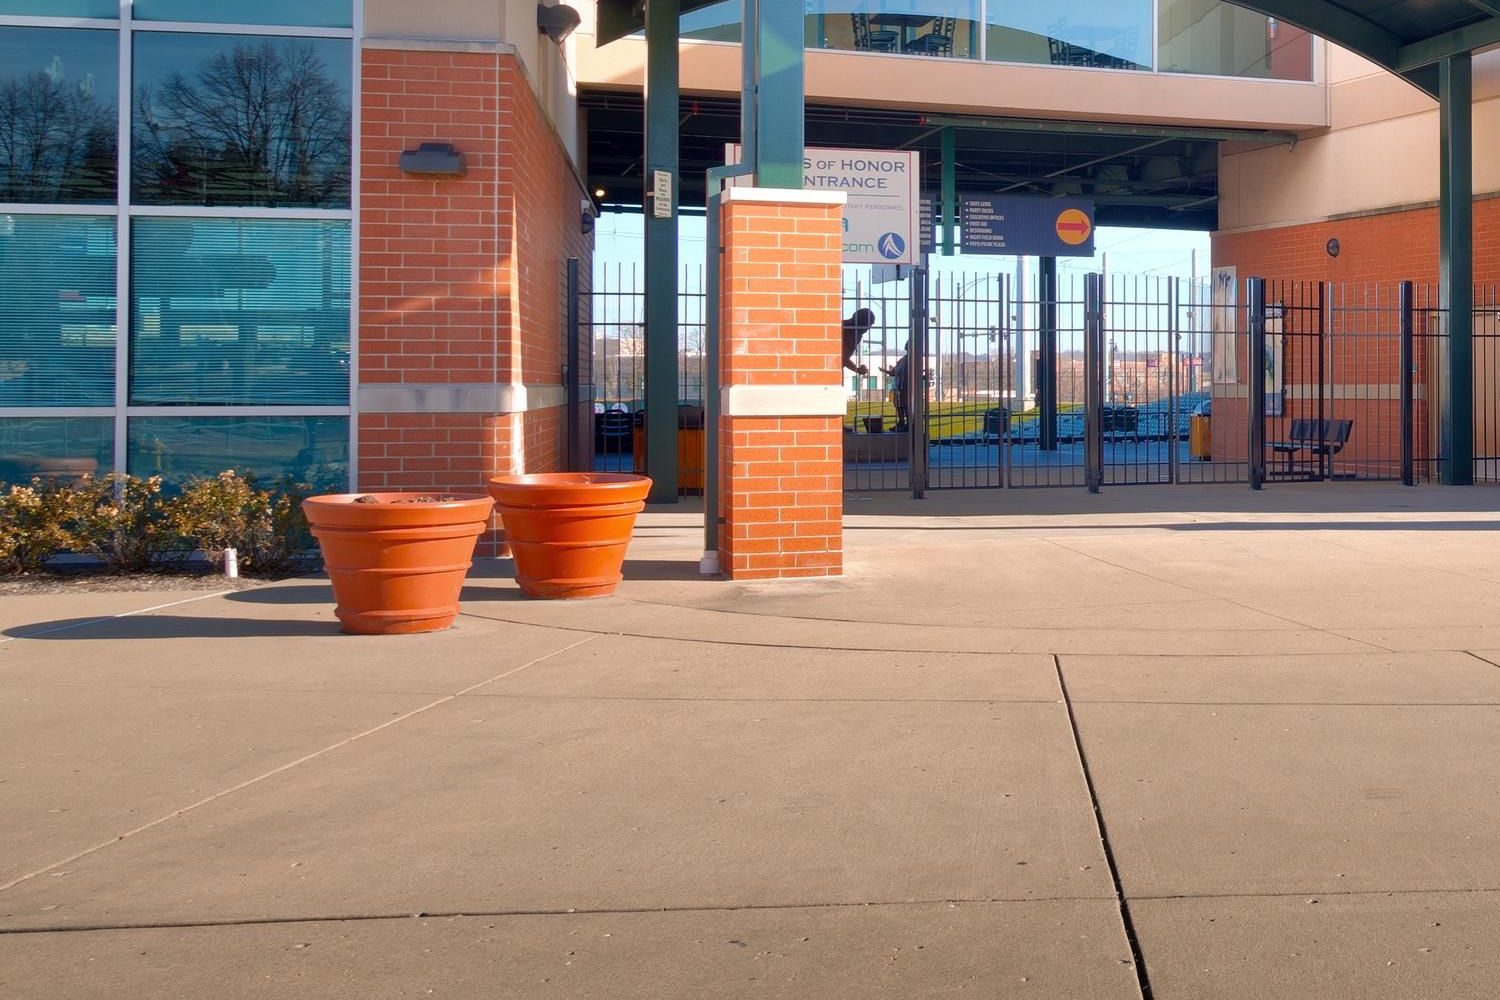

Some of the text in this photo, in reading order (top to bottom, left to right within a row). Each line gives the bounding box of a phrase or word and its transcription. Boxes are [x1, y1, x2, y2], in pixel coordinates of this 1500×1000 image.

[816, 160, 836, 170] OF
[841, 159, 905, 173] HONOR
[804, 175, 888, 189] NTRANCE
